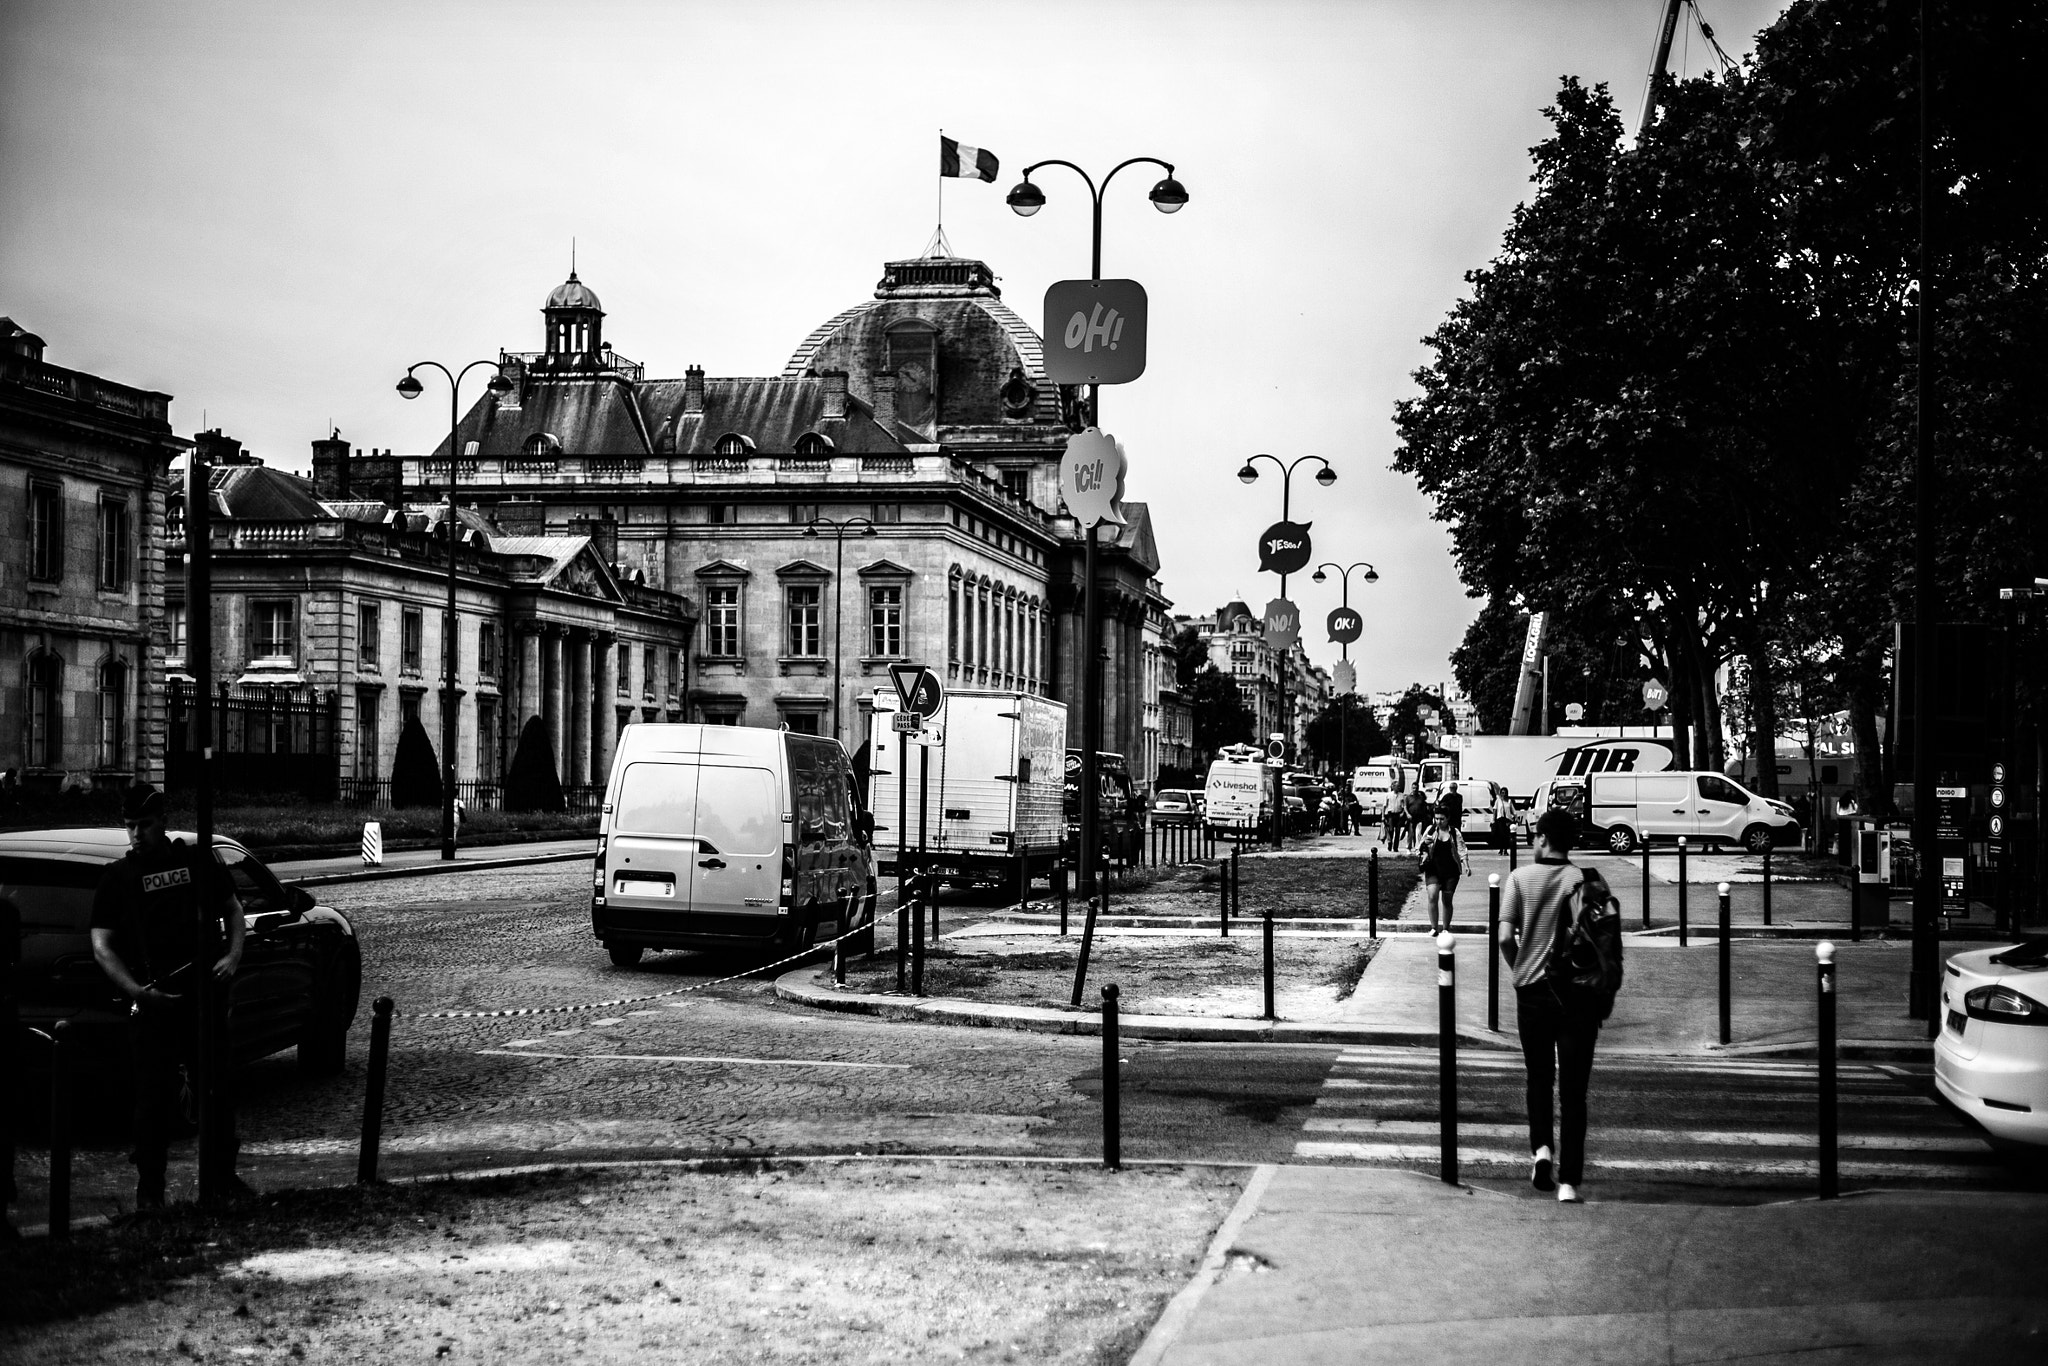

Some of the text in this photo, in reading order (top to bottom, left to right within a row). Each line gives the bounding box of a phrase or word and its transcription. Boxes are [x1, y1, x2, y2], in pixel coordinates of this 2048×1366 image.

[1064, 302, 1125, 353] OH!
[1269, 614, 1294, 632] NO!
[1334, 617, 1356, 631] OK!
[896, 714, 912, 722] CÉDE
[1223, 780, 1258, 791] Liveshot
[144, 869, 189, 891] POLICE
